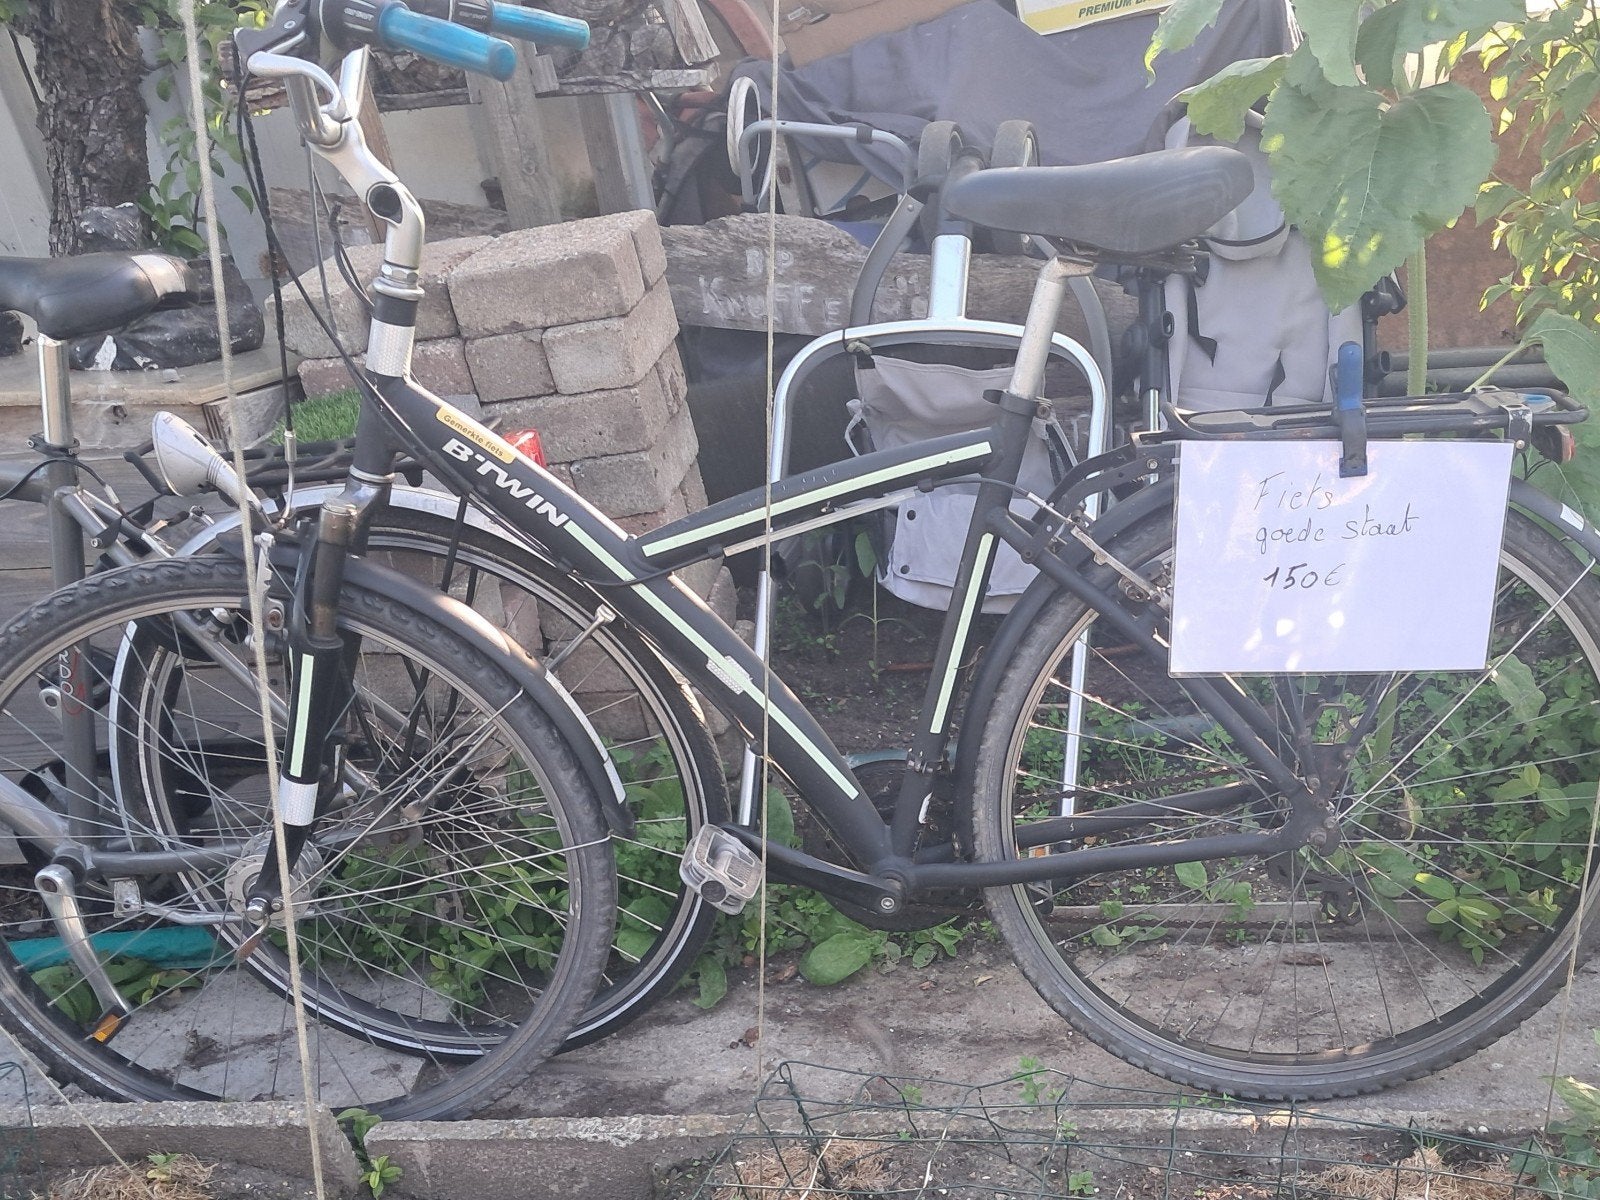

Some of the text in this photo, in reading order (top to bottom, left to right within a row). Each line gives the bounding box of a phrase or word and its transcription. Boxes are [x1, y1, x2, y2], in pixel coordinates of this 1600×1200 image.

[442, 413, 505, 458] Gemerkte fiets
[1253, 471, 1334, 511] Fiets
[1255, 517, 1326, 555] goede
[1262, 562, 1346, 590] 150€
